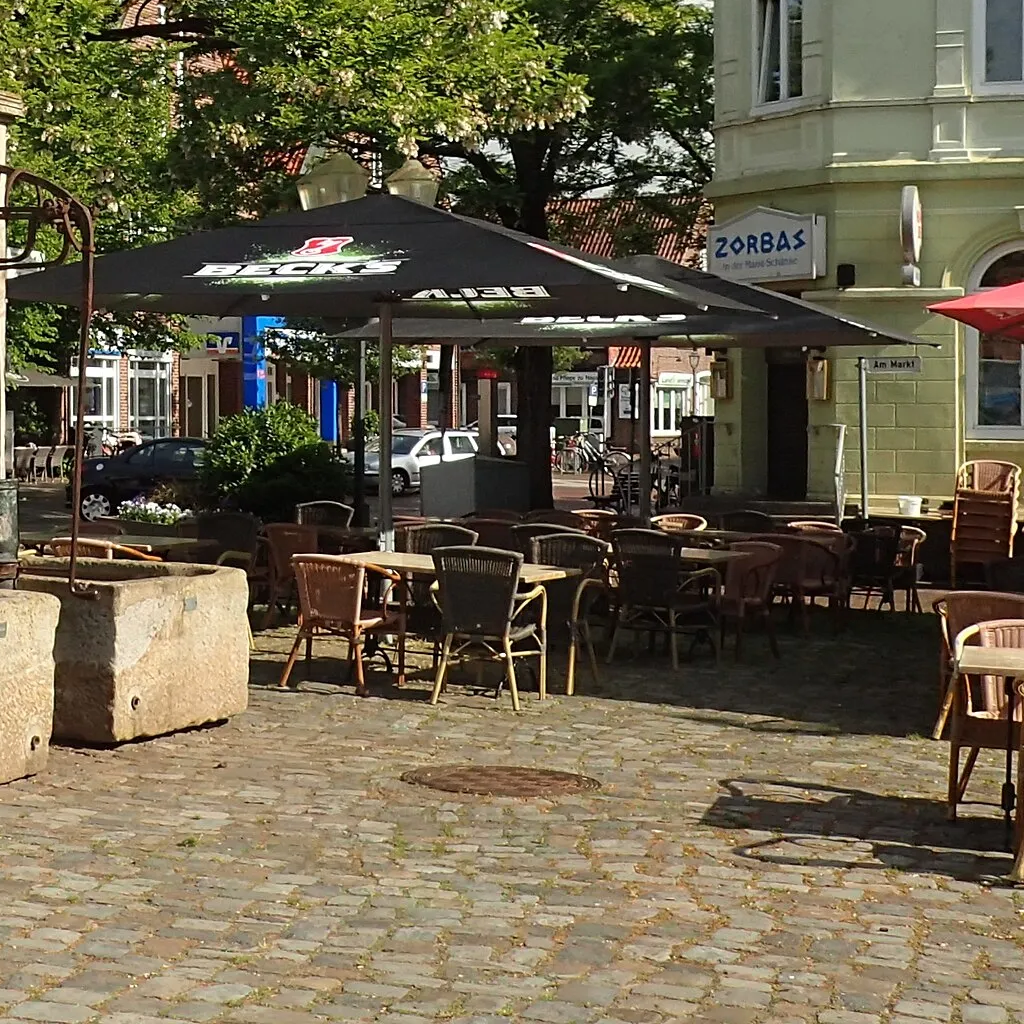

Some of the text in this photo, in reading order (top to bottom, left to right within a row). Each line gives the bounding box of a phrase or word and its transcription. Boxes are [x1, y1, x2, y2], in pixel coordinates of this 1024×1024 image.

[715, 229, 806, 258] ZORBAS
[873, 359, 915, 369] Am Markt
